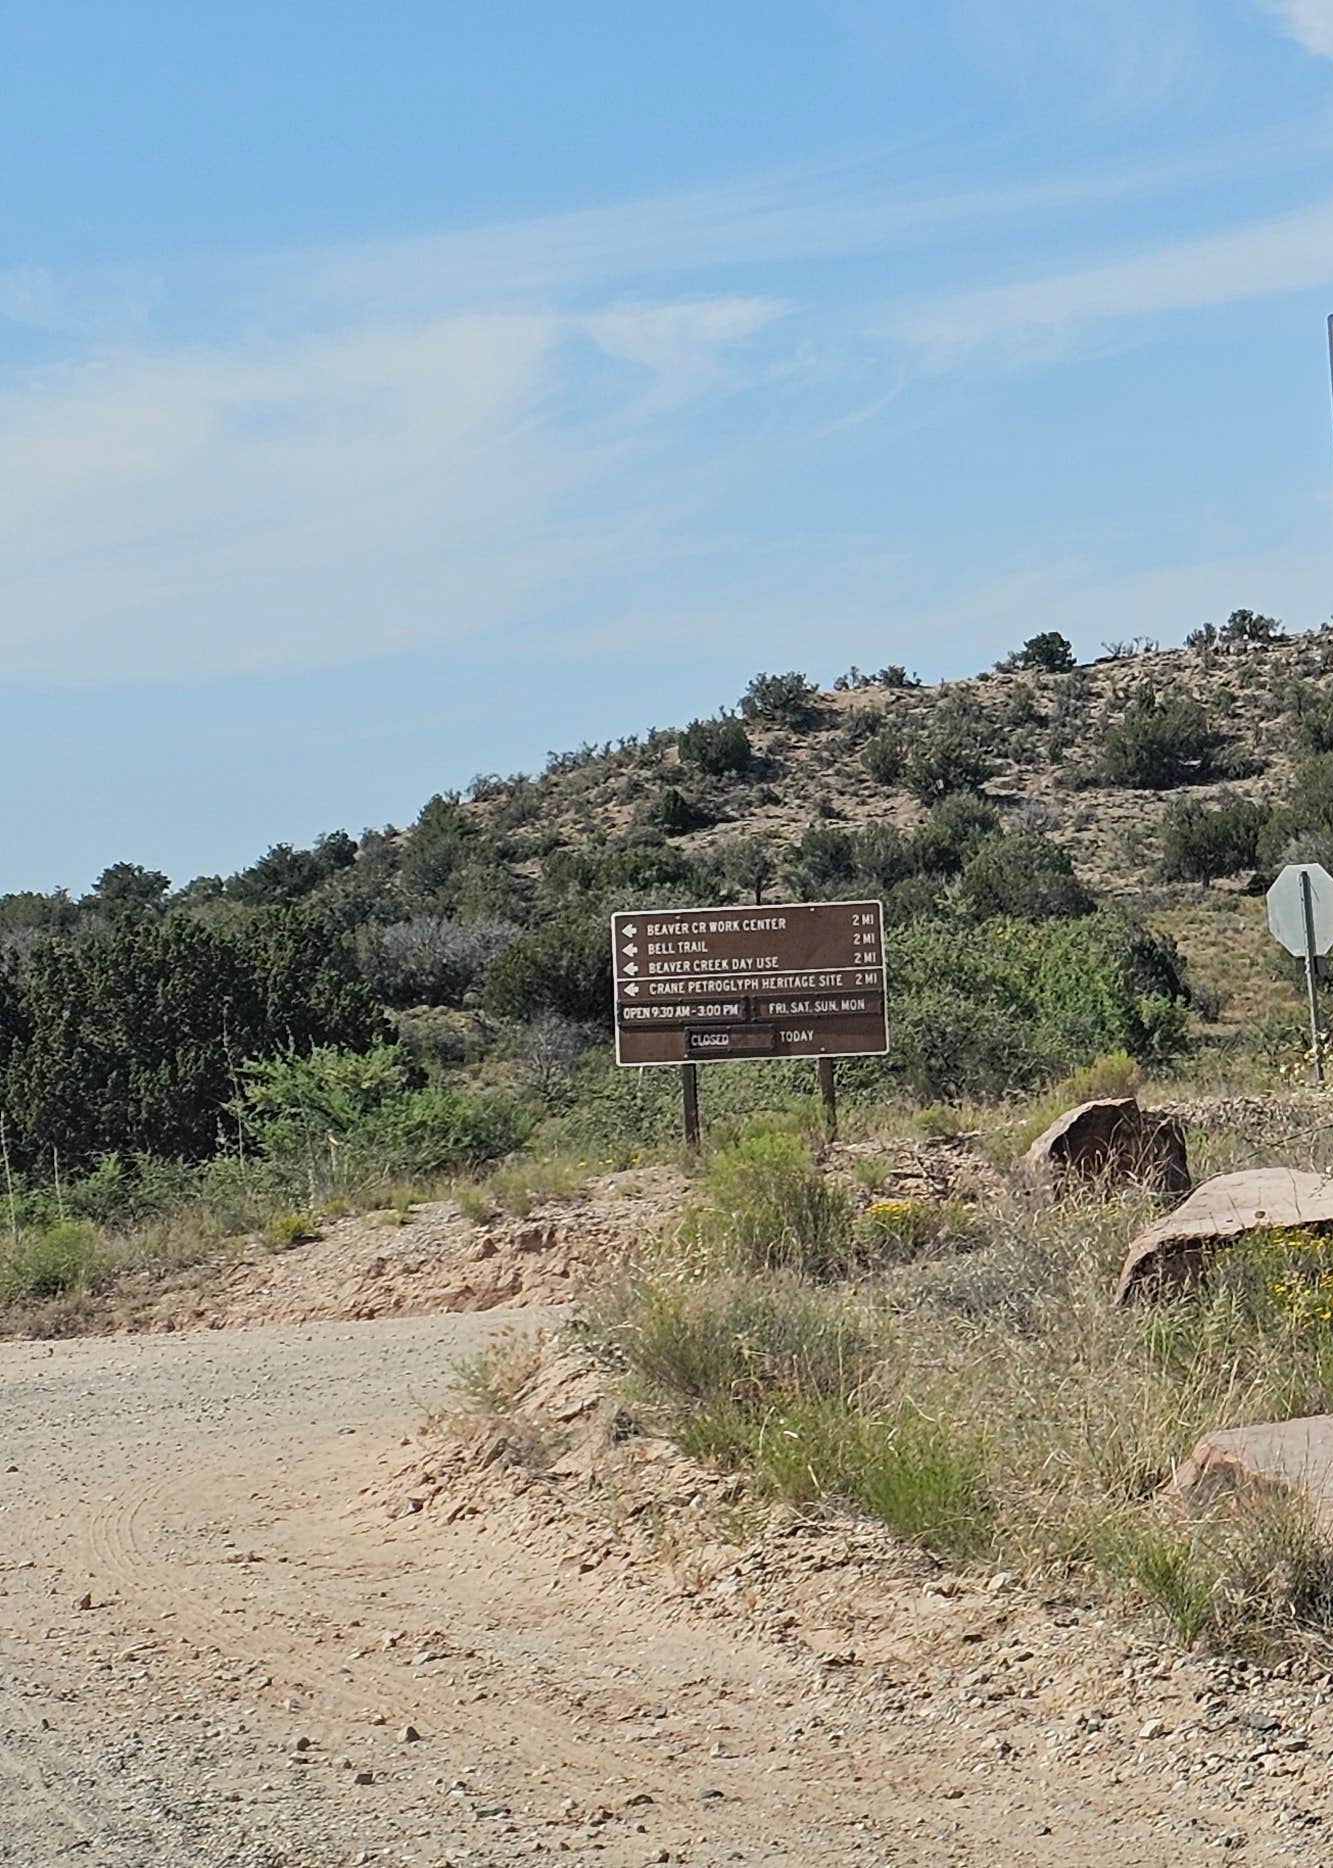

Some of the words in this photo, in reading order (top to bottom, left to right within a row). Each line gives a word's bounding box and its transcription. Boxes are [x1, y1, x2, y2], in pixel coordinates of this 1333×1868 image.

[647, 922, 689, 936] BEAVER
[691, 921, 707, 934] CR
[709, 920, 741, 933] WORK
[742, 918, 787, 931] CENTER
[852, 914, 860, 926] 2
[861, 913, 874, 926] MI
[648, 942, 675, 955] BELL
[677, 941, 709, 953] TRAIL
[853, 933, 861, 945] 2
[862, 932, 875, 945] MI
[648, 961, 691, 974] BEAVER
[693, 959, 729, 972] CREEK
[732, 958, 754, 970] DAY
[756, 956, 779, 969] USE
[854, 952, 862, 964] 2
[863, 951, 876, 963] MI
[649, 982, 685, 995] CRANE
[688, 979, 759, 993] PETROGLYPH
[761, 975, 816, 989] HERITAGE
[818, 974, 843, 987] SITE
[855, 973, 863, 985] 2
[864, 972, 877, 985] MI
[623, 1007, 651, 1019] OPEN
[674, 1005, 691, 1018] AM
[722, 1004, 739, 1016] PM
[841, 999, 865, 1011] MON
[691, 1034, 729, 1046] CLOSED
[780, 1030, 814, 1042] TODAY
